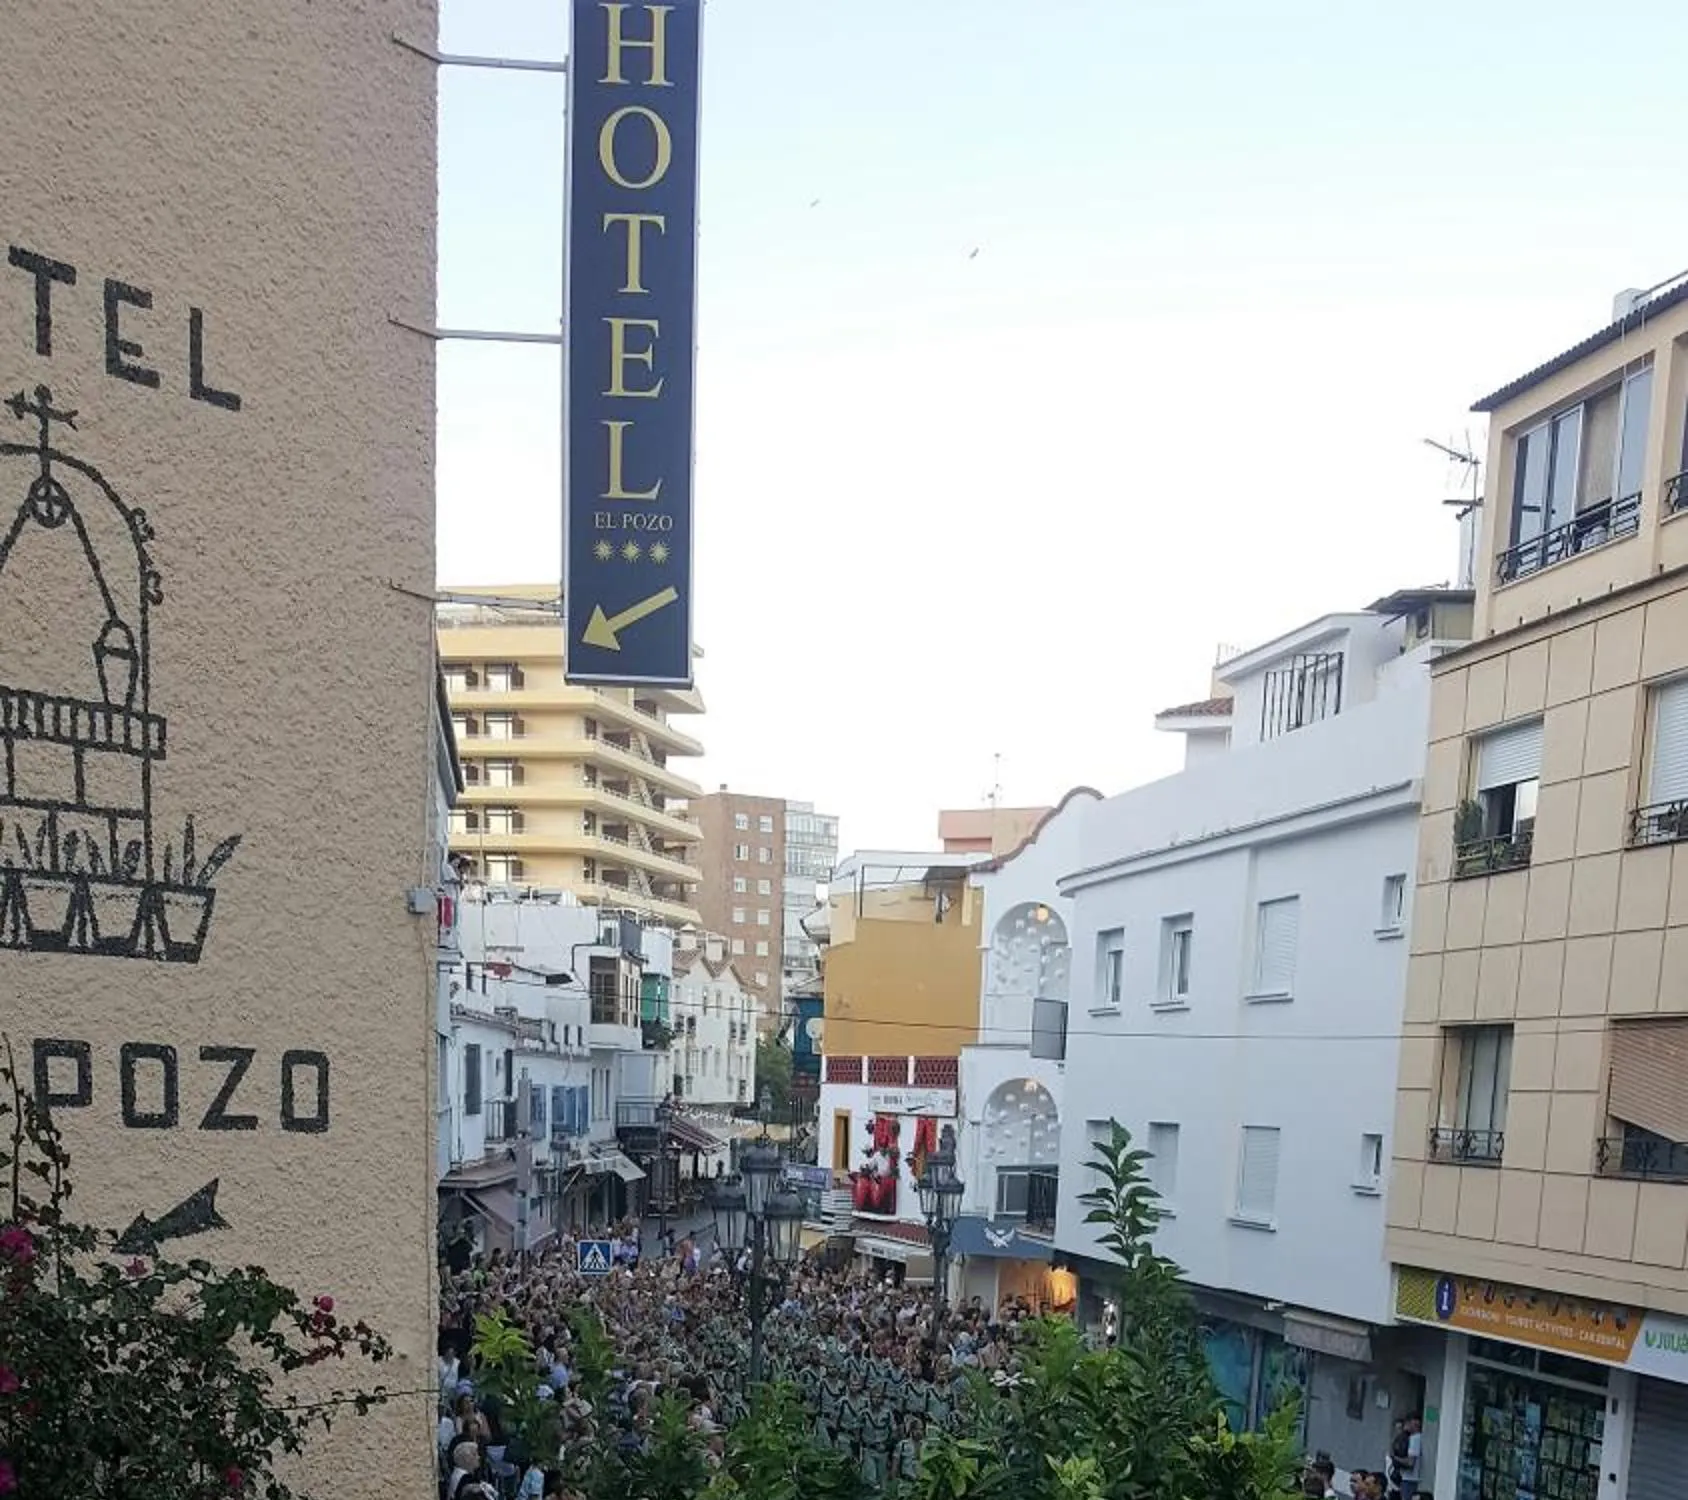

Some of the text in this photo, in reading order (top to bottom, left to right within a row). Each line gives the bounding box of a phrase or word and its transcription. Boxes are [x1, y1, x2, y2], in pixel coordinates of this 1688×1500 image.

[597, 3, 676, 500] HOTEL
[594, 511, 673, 531] EL POZO
[33, 1038, 330, 1133] POZO
